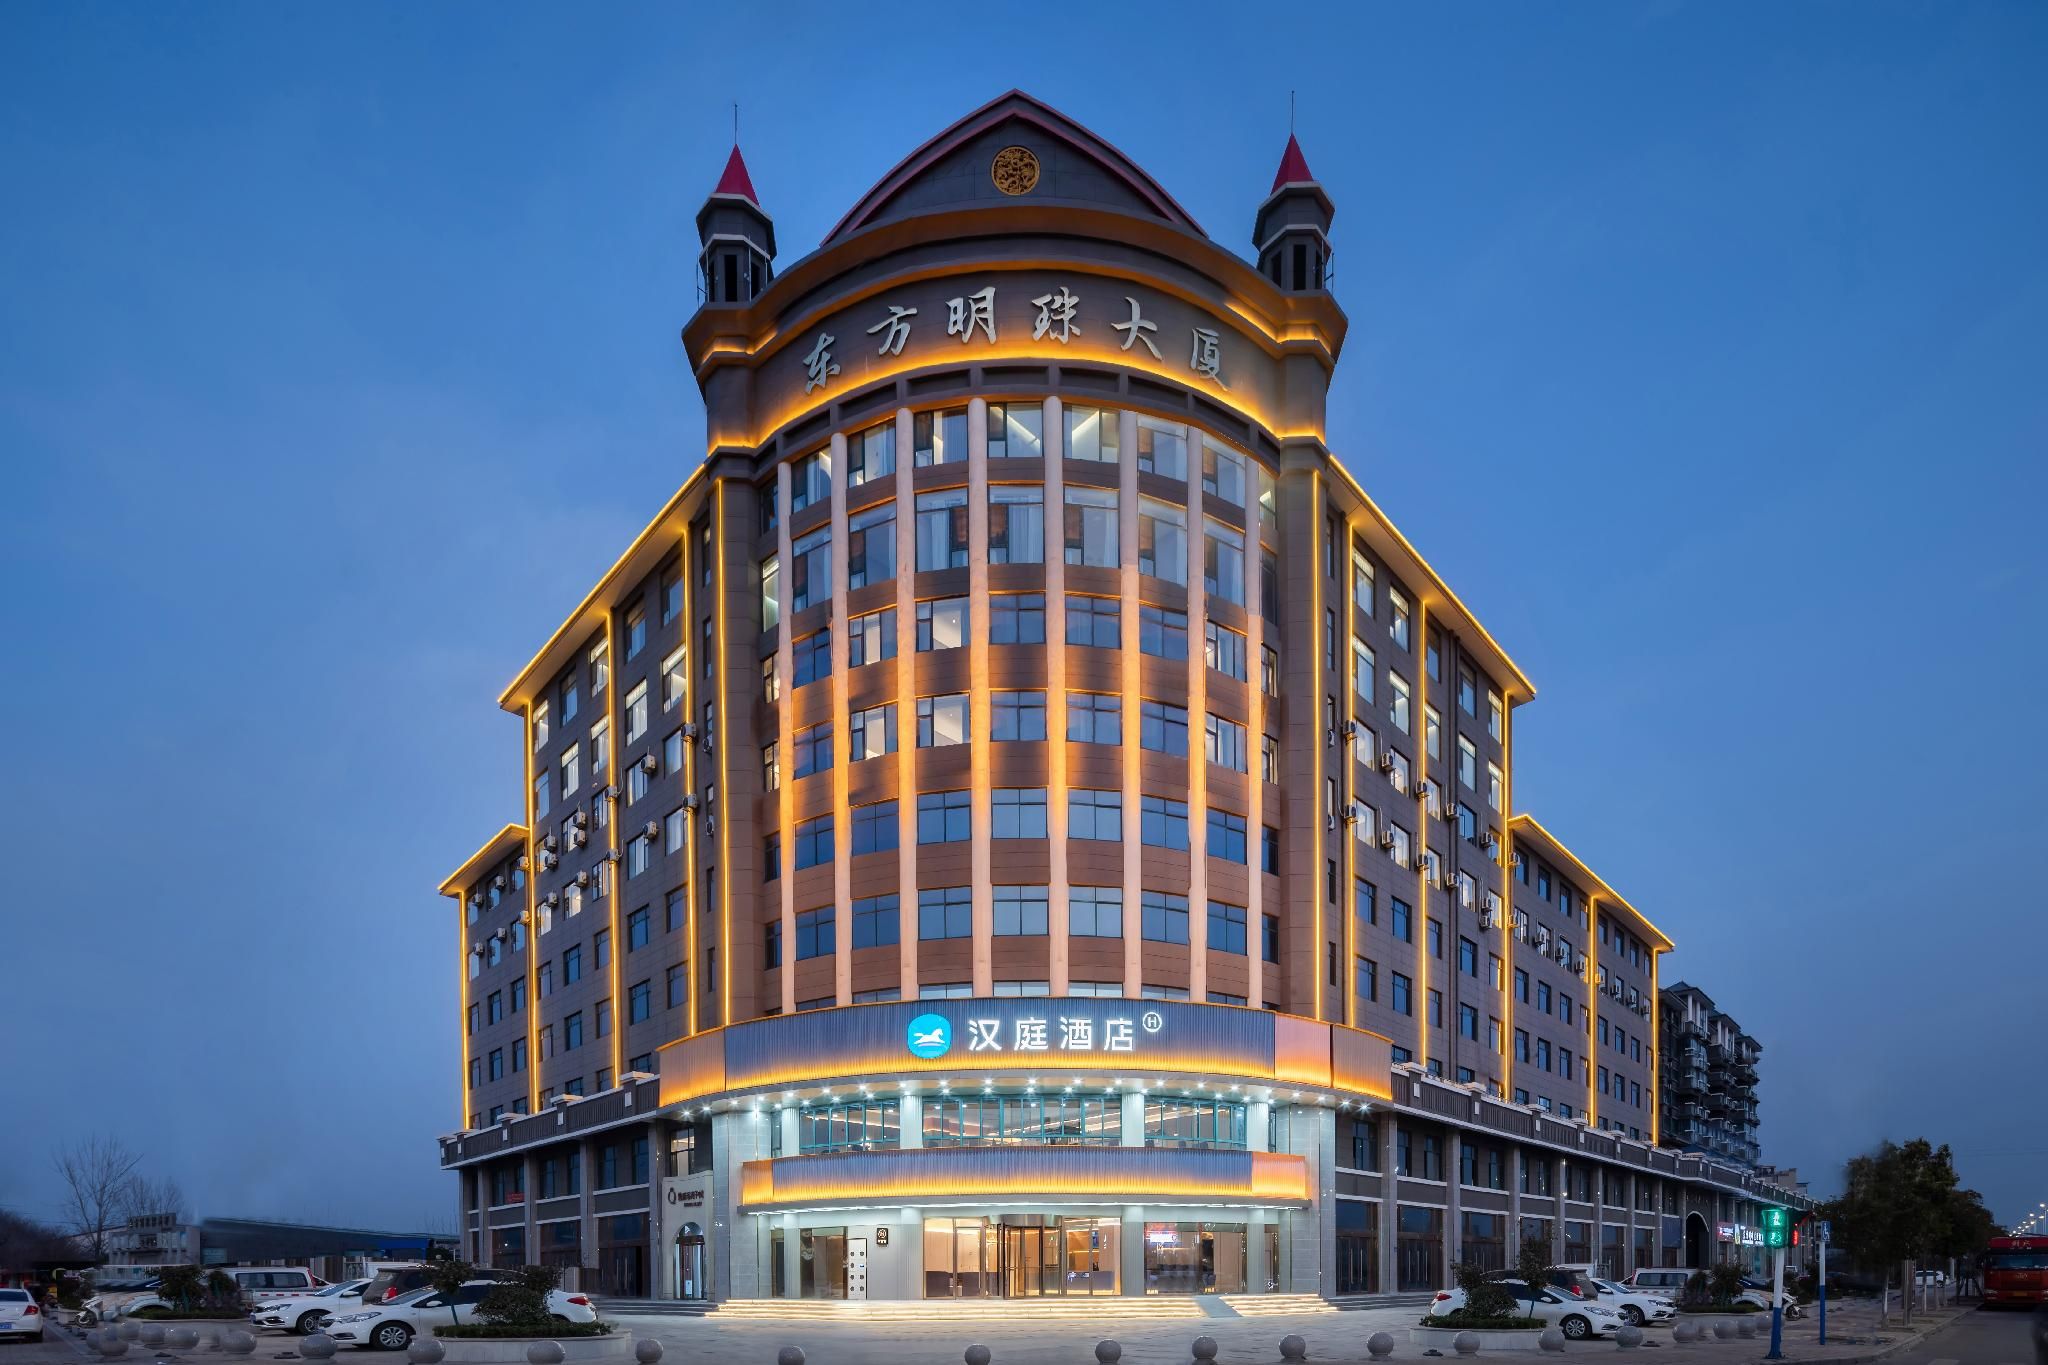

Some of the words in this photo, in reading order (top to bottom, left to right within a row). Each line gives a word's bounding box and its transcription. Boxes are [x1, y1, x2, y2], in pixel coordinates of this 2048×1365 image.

[802, 286, 1232, 393] 东方明珠大厦
[967, 1016, 1134, 1051] 汉庭酒店
